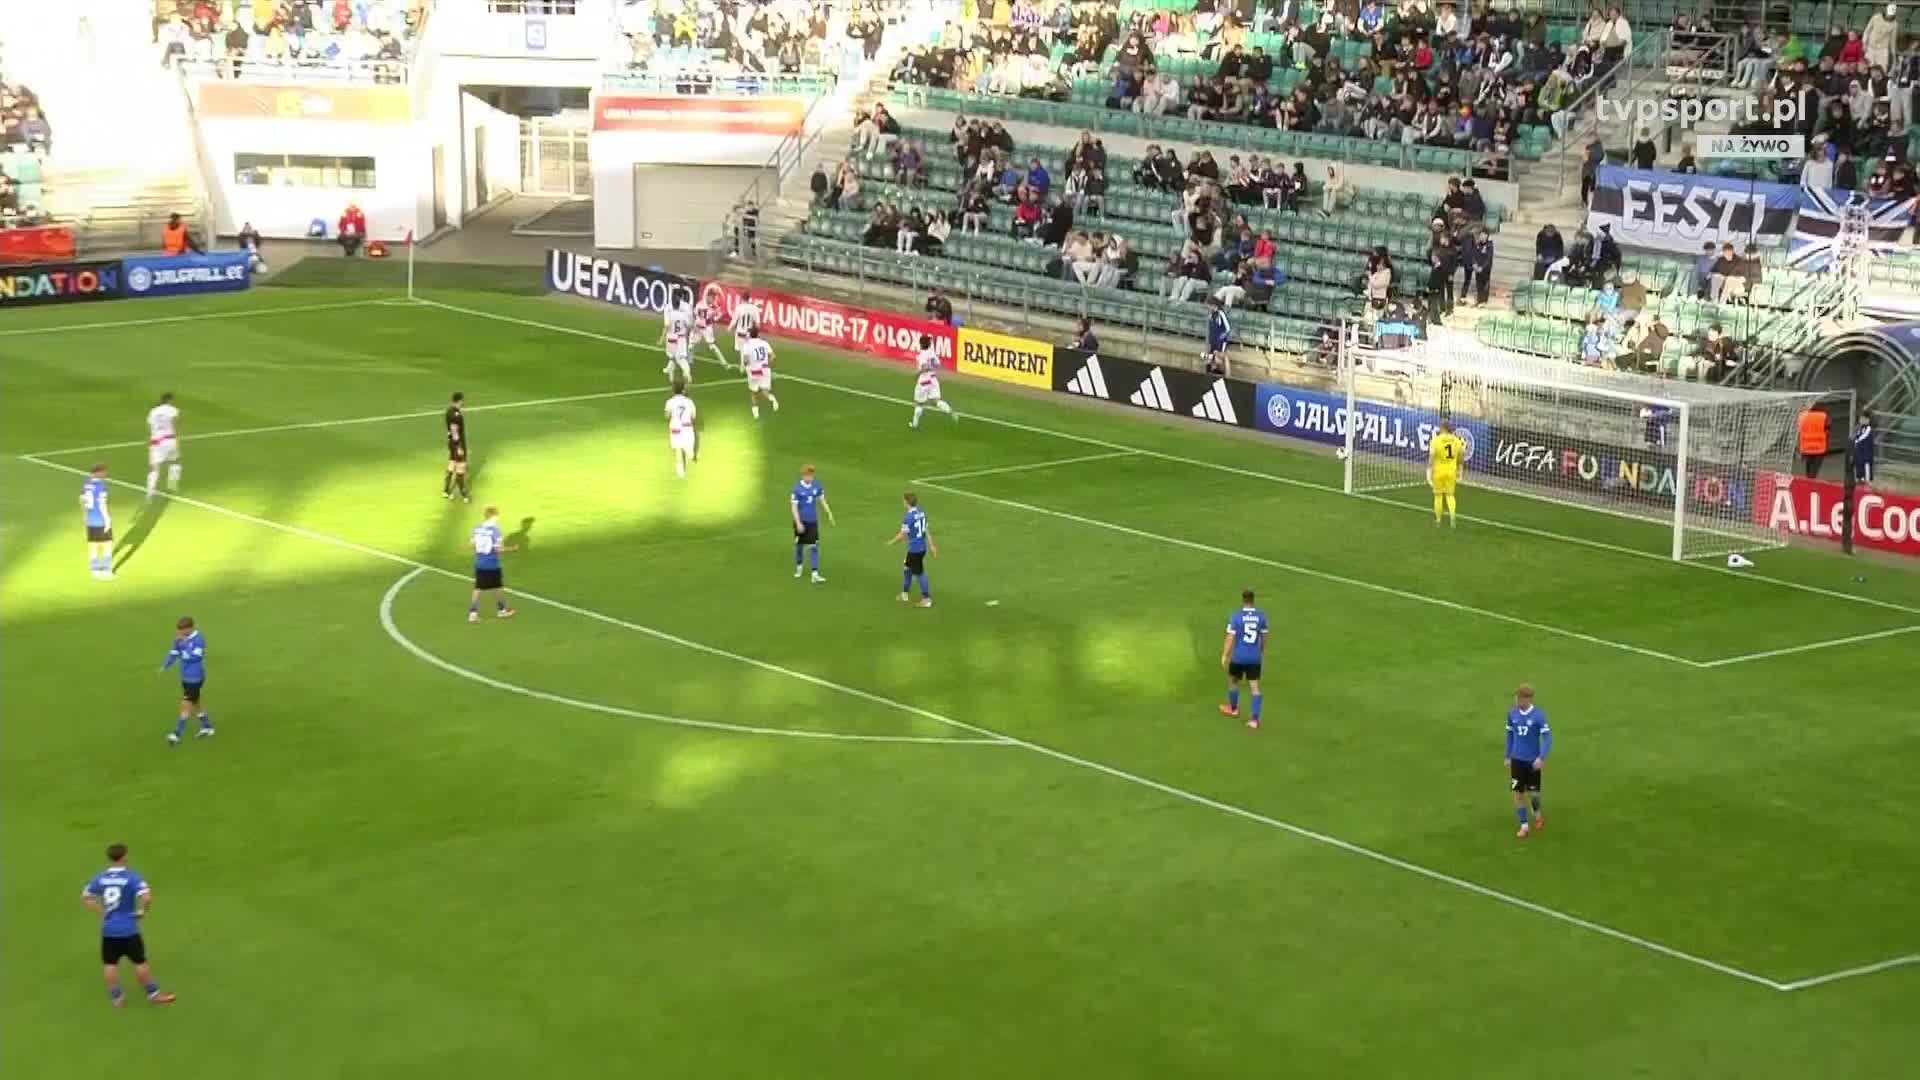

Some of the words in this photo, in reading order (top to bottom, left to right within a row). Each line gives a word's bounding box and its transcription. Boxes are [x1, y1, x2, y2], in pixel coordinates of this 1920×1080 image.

[1622, 180, 1767, 241] EESTI
[754, 346, 767, 361] 19
[887, 325, 952, 359] LOXM
[963, 341, 1048, 376] RAMIRENT
[1444, 444, 1454, 460] 1
[1495, 439, 1556, 472] UEFA
[1243, 621, 1258, 644] 5
[1517, 726, 1528, 735] 17
[103, 886, 121, 912] 9
